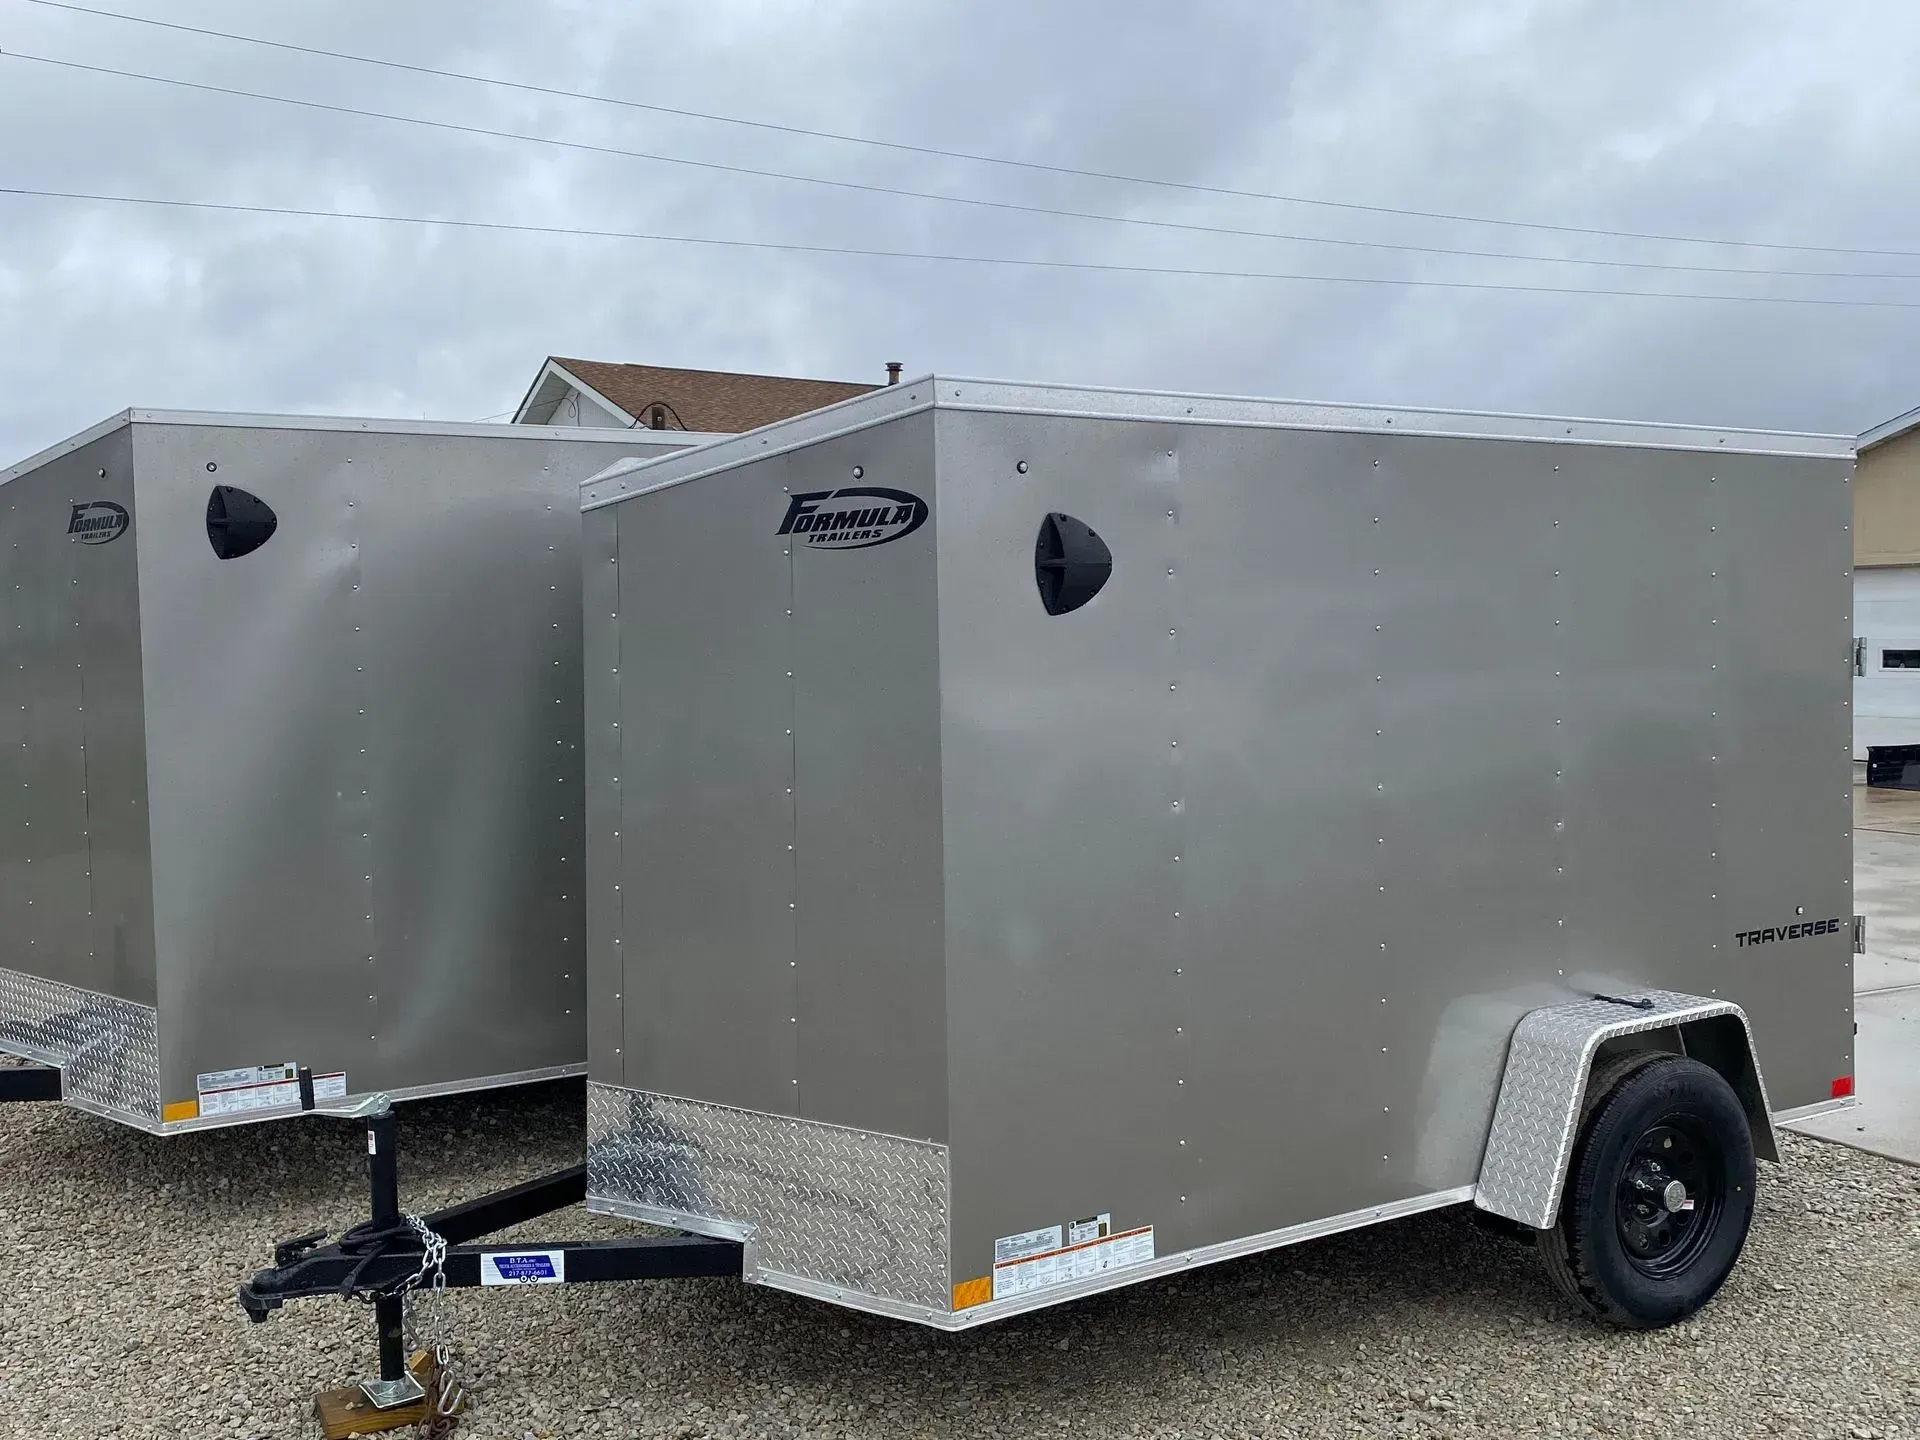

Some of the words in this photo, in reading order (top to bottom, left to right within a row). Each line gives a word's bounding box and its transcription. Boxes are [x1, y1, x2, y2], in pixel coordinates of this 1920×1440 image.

[67, 503, 123, 533] FORMULA
[775, 490, 915, 535] FORMULA
[808, 529, 884, 543] TRAILERS
[1735, 918, 1840, 947] TRAVERSE
